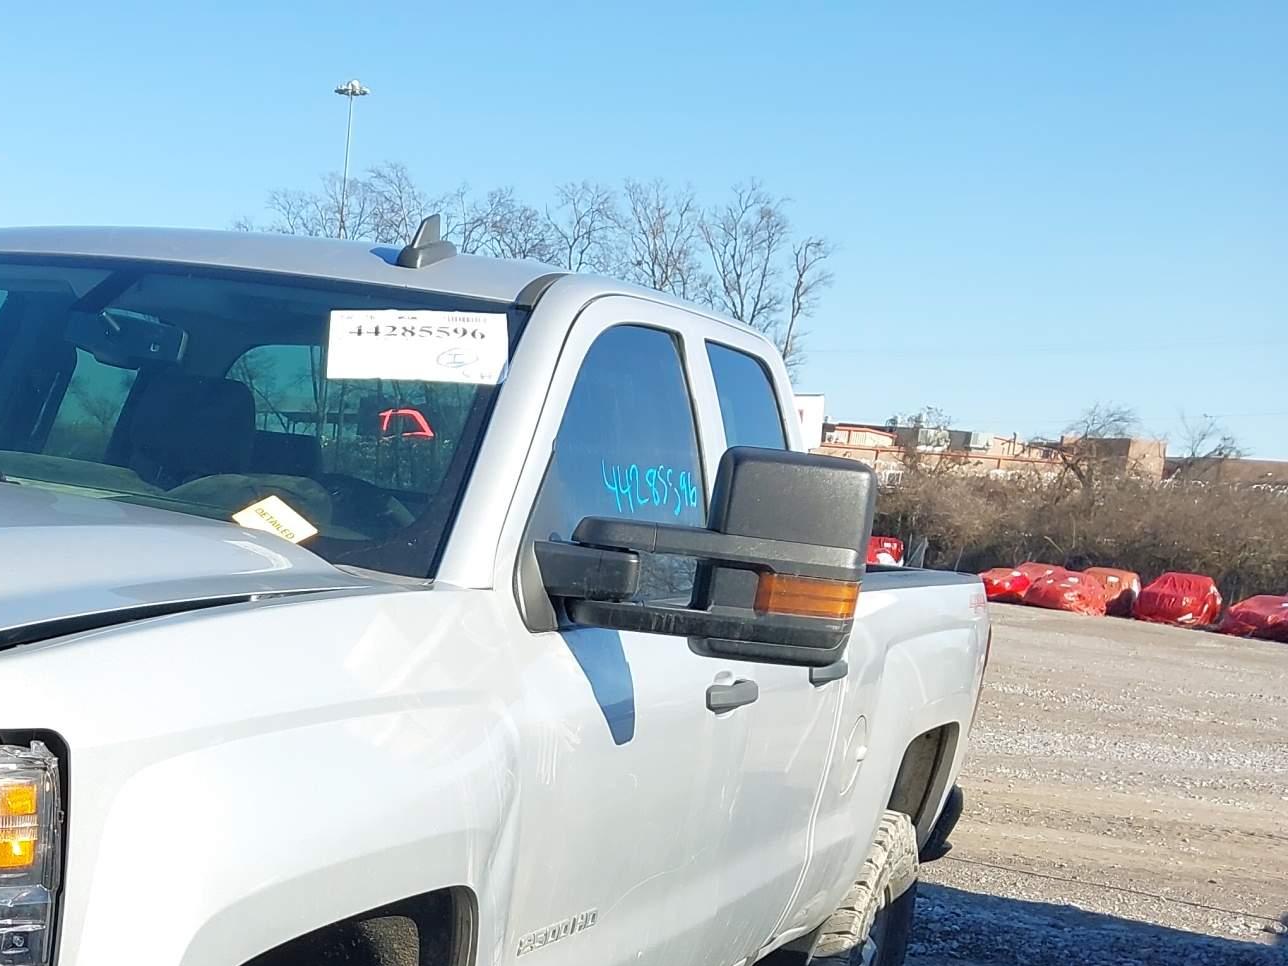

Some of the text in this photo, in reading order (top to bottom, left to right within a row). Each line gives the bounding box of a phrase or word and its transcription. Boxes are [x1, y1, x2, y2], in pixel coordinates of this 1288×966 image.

[348, 324, 486, 341] 44285596
[601, 458, 697, 516] 44285596
[254, 507, 295, 540] DETAILED
